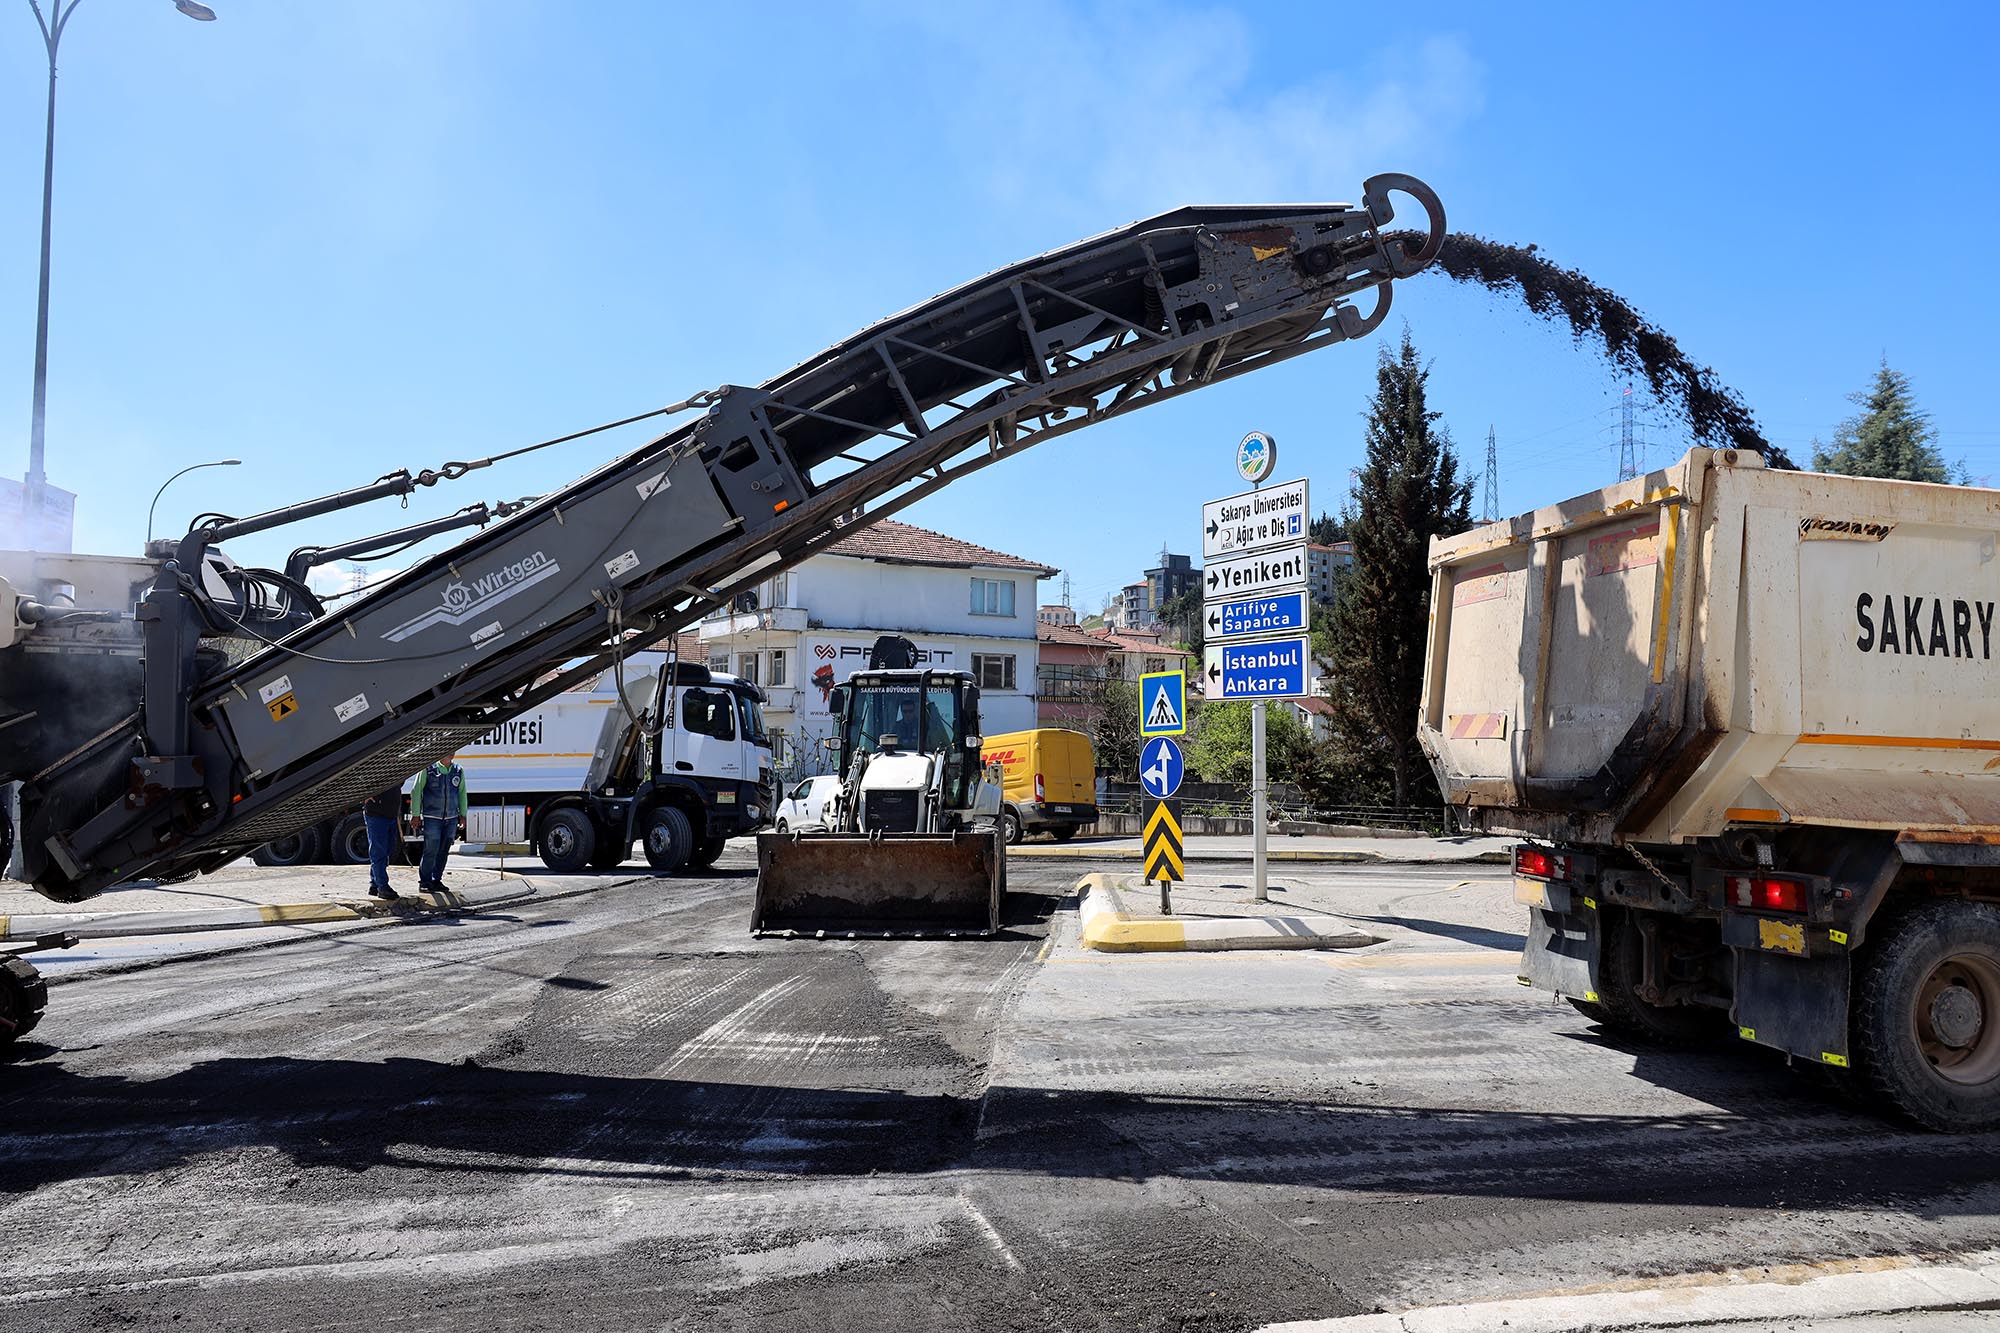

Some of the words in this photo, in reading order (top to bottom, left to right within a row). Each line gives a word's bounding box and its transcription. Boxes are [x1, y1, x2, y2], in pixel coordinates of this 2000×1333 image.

[1221, 504, 1251, 523] Sakarya
[1253, 489, 1303, 516] Üniversitesi
[1236, 525, 1254, 547] Ağız
[1257, 524, 1268, 539] ve
[1271, 517, 1285, 538] Diş
[471, 550, 548, 598] Wirtgen
[1222, 555, 1302, 589] Yenikent
[1225, 602, 1278, 618] Arifiye
[1225, 615, 1291, 633] Sapanca
[1856, 592, 1995, 660] SAKARY
[1225, 648, 1298, 671] İstanbul
[860, 686, 886, 694] SAKARYA
[926, 686, 952, 694] LEDİYESİ
[1225, 676, 1288, 693] Ankara
